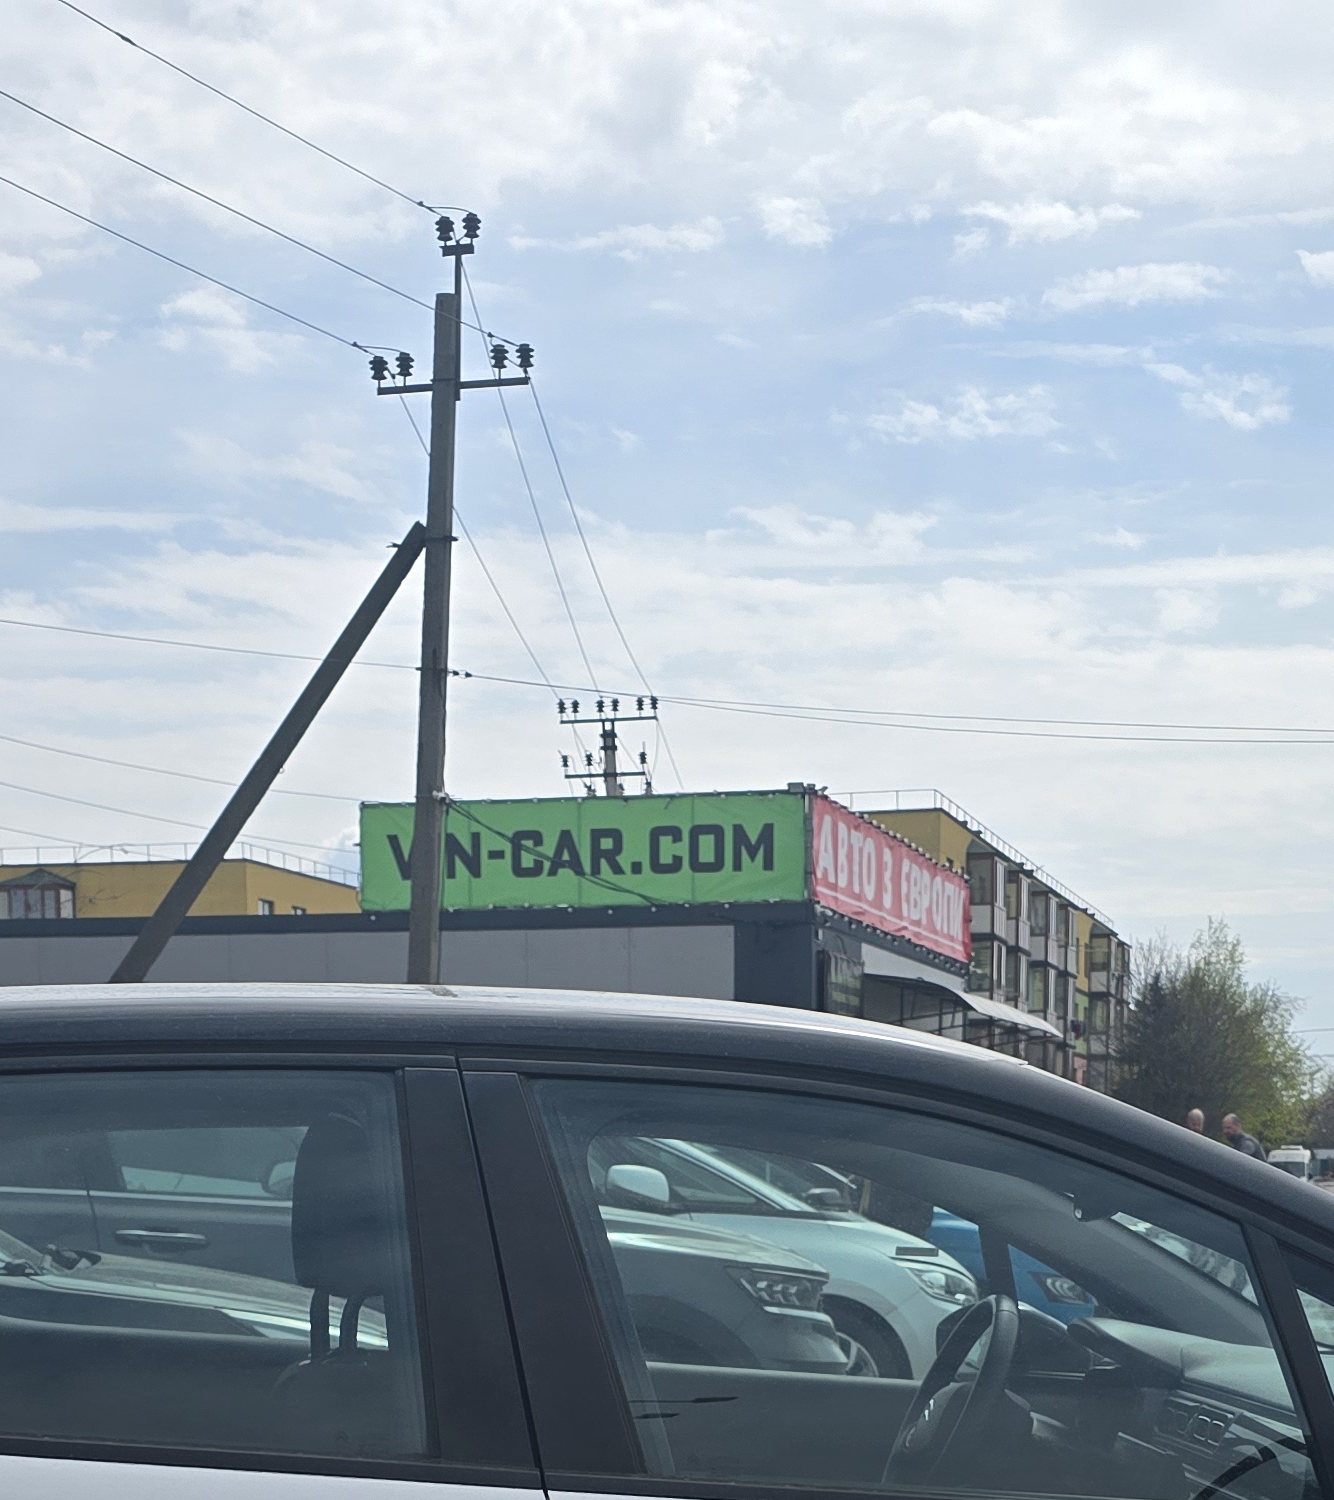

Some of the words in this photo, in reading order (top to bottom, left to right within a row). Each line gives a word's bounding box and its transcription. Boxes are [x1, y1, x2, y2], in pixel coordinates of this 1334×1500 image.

[386, 823, 775, 881] VN-CAR.COM
[817, 814, 876, 901] АВТО
[882, 847, 893, 909] З
[901, 858, 965, 941] ЄВРОПИ
